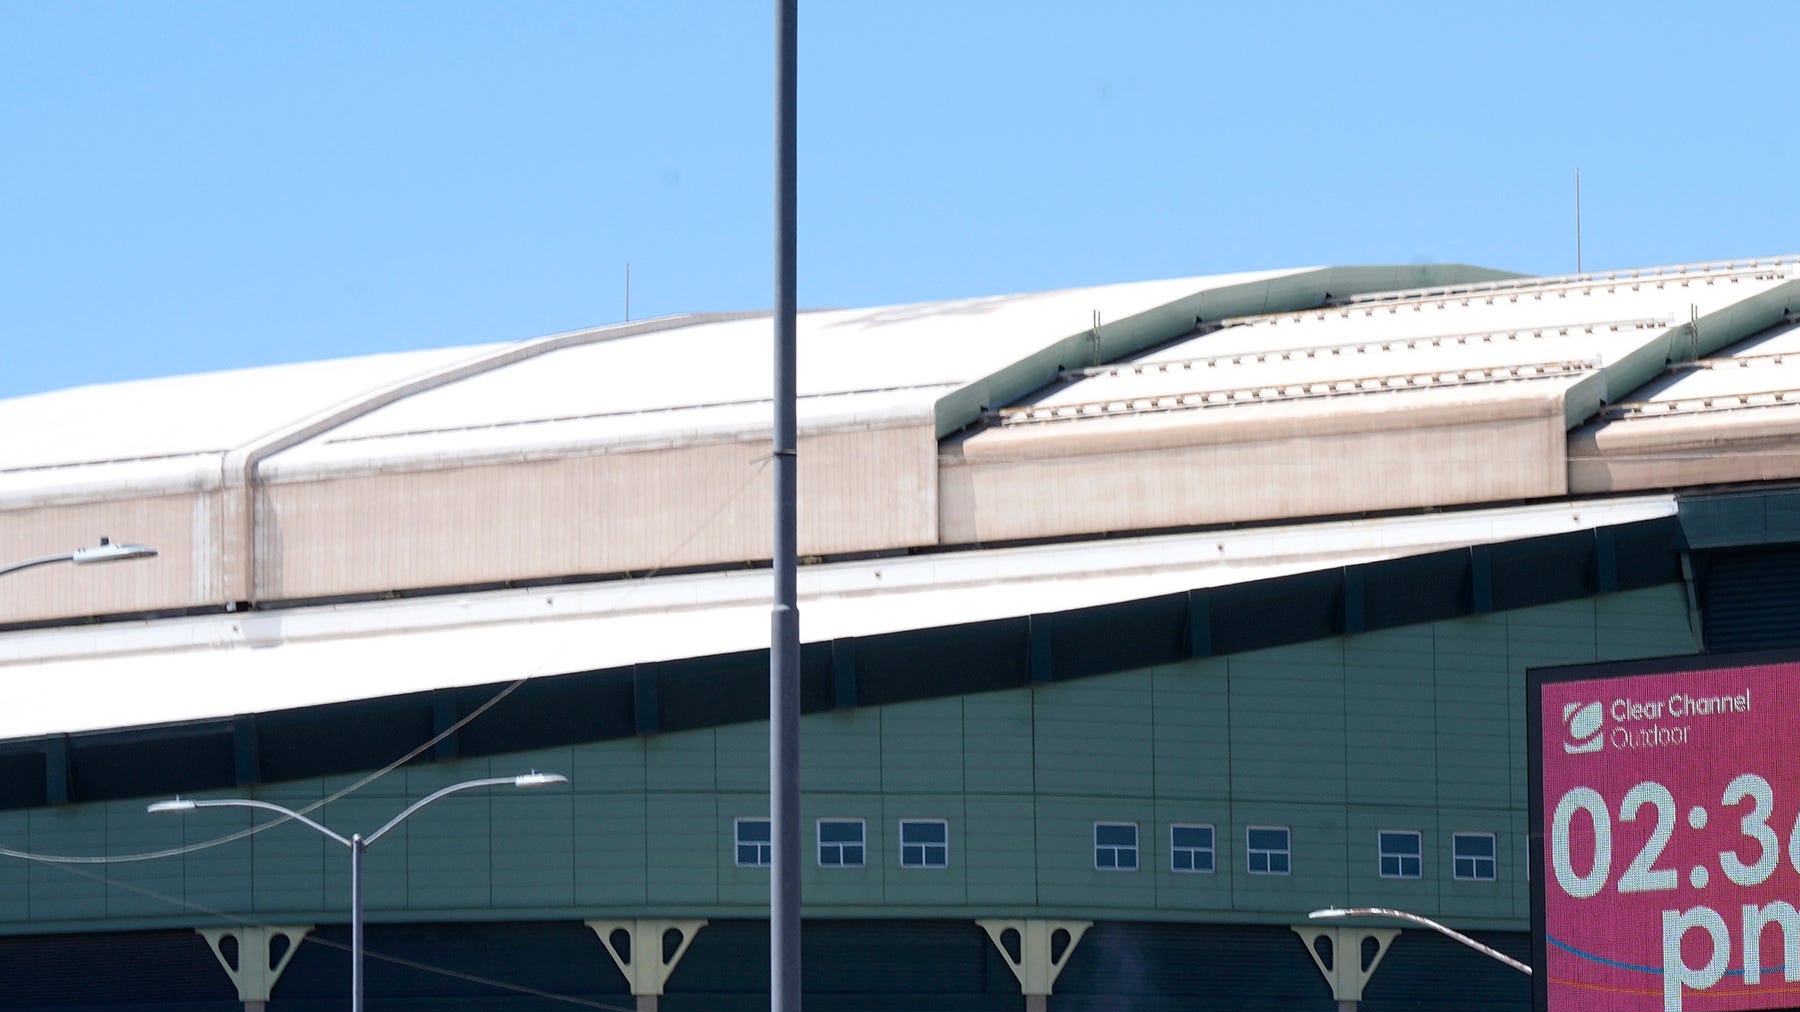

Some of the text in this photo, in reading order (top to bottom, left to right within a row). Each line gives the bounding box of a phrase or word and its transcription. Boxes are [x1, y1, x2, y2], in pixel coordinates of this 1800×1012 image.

[1610, 688, 1751, 722] Clear Channel
[1611, 724, 1690, 750] Outdoor
